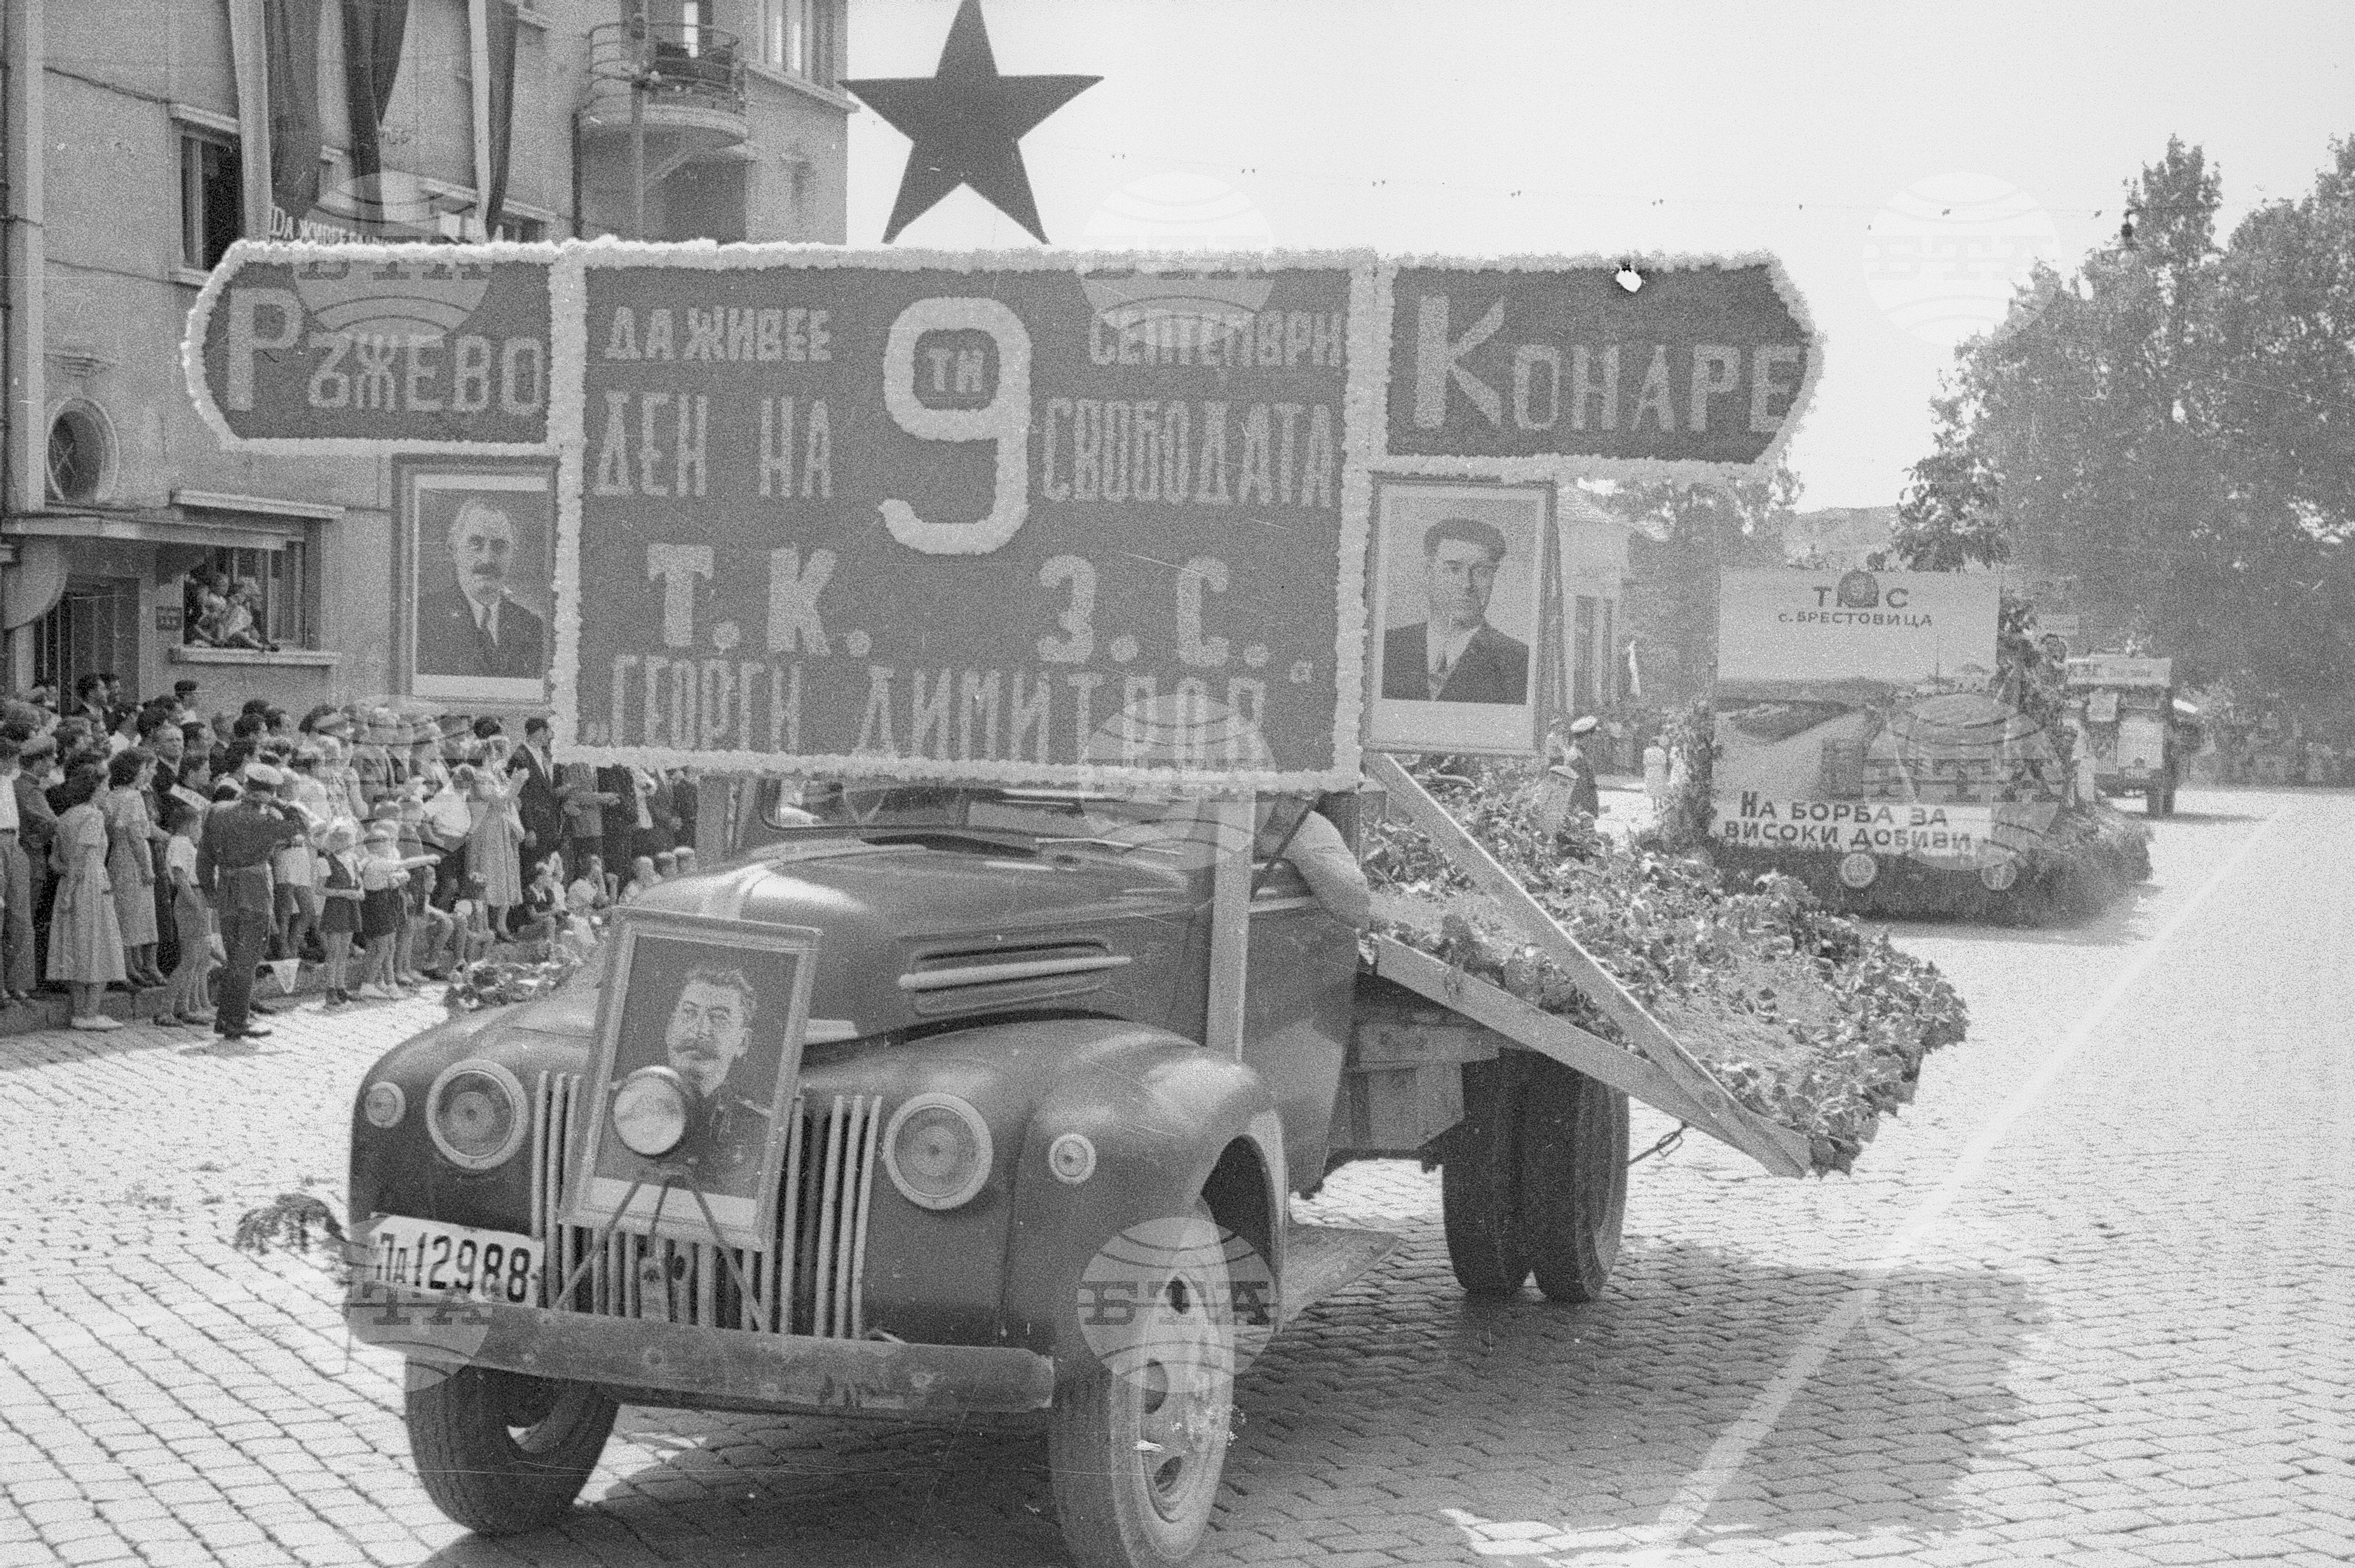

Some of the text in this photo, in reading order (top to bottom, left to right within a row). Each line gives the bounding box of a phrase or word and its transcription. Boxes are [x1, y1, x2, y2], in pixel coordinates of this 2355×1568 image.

[605, 305, 832, 362] ДА ЖИВЕЕ
[928, 347, 984, 394] ТИ
[1414, 294, 1802, 431] КОНАРЕ
[593, 389, 1335, 507] ДЕН НА СВОБОДАТА
[879, 296, 1031, 555] 9
[1724, 820, 1971, 851] ВИСОКИ ДОБИВИ
[1741, 790, 1948, 826] НА БОРБА ЗА
